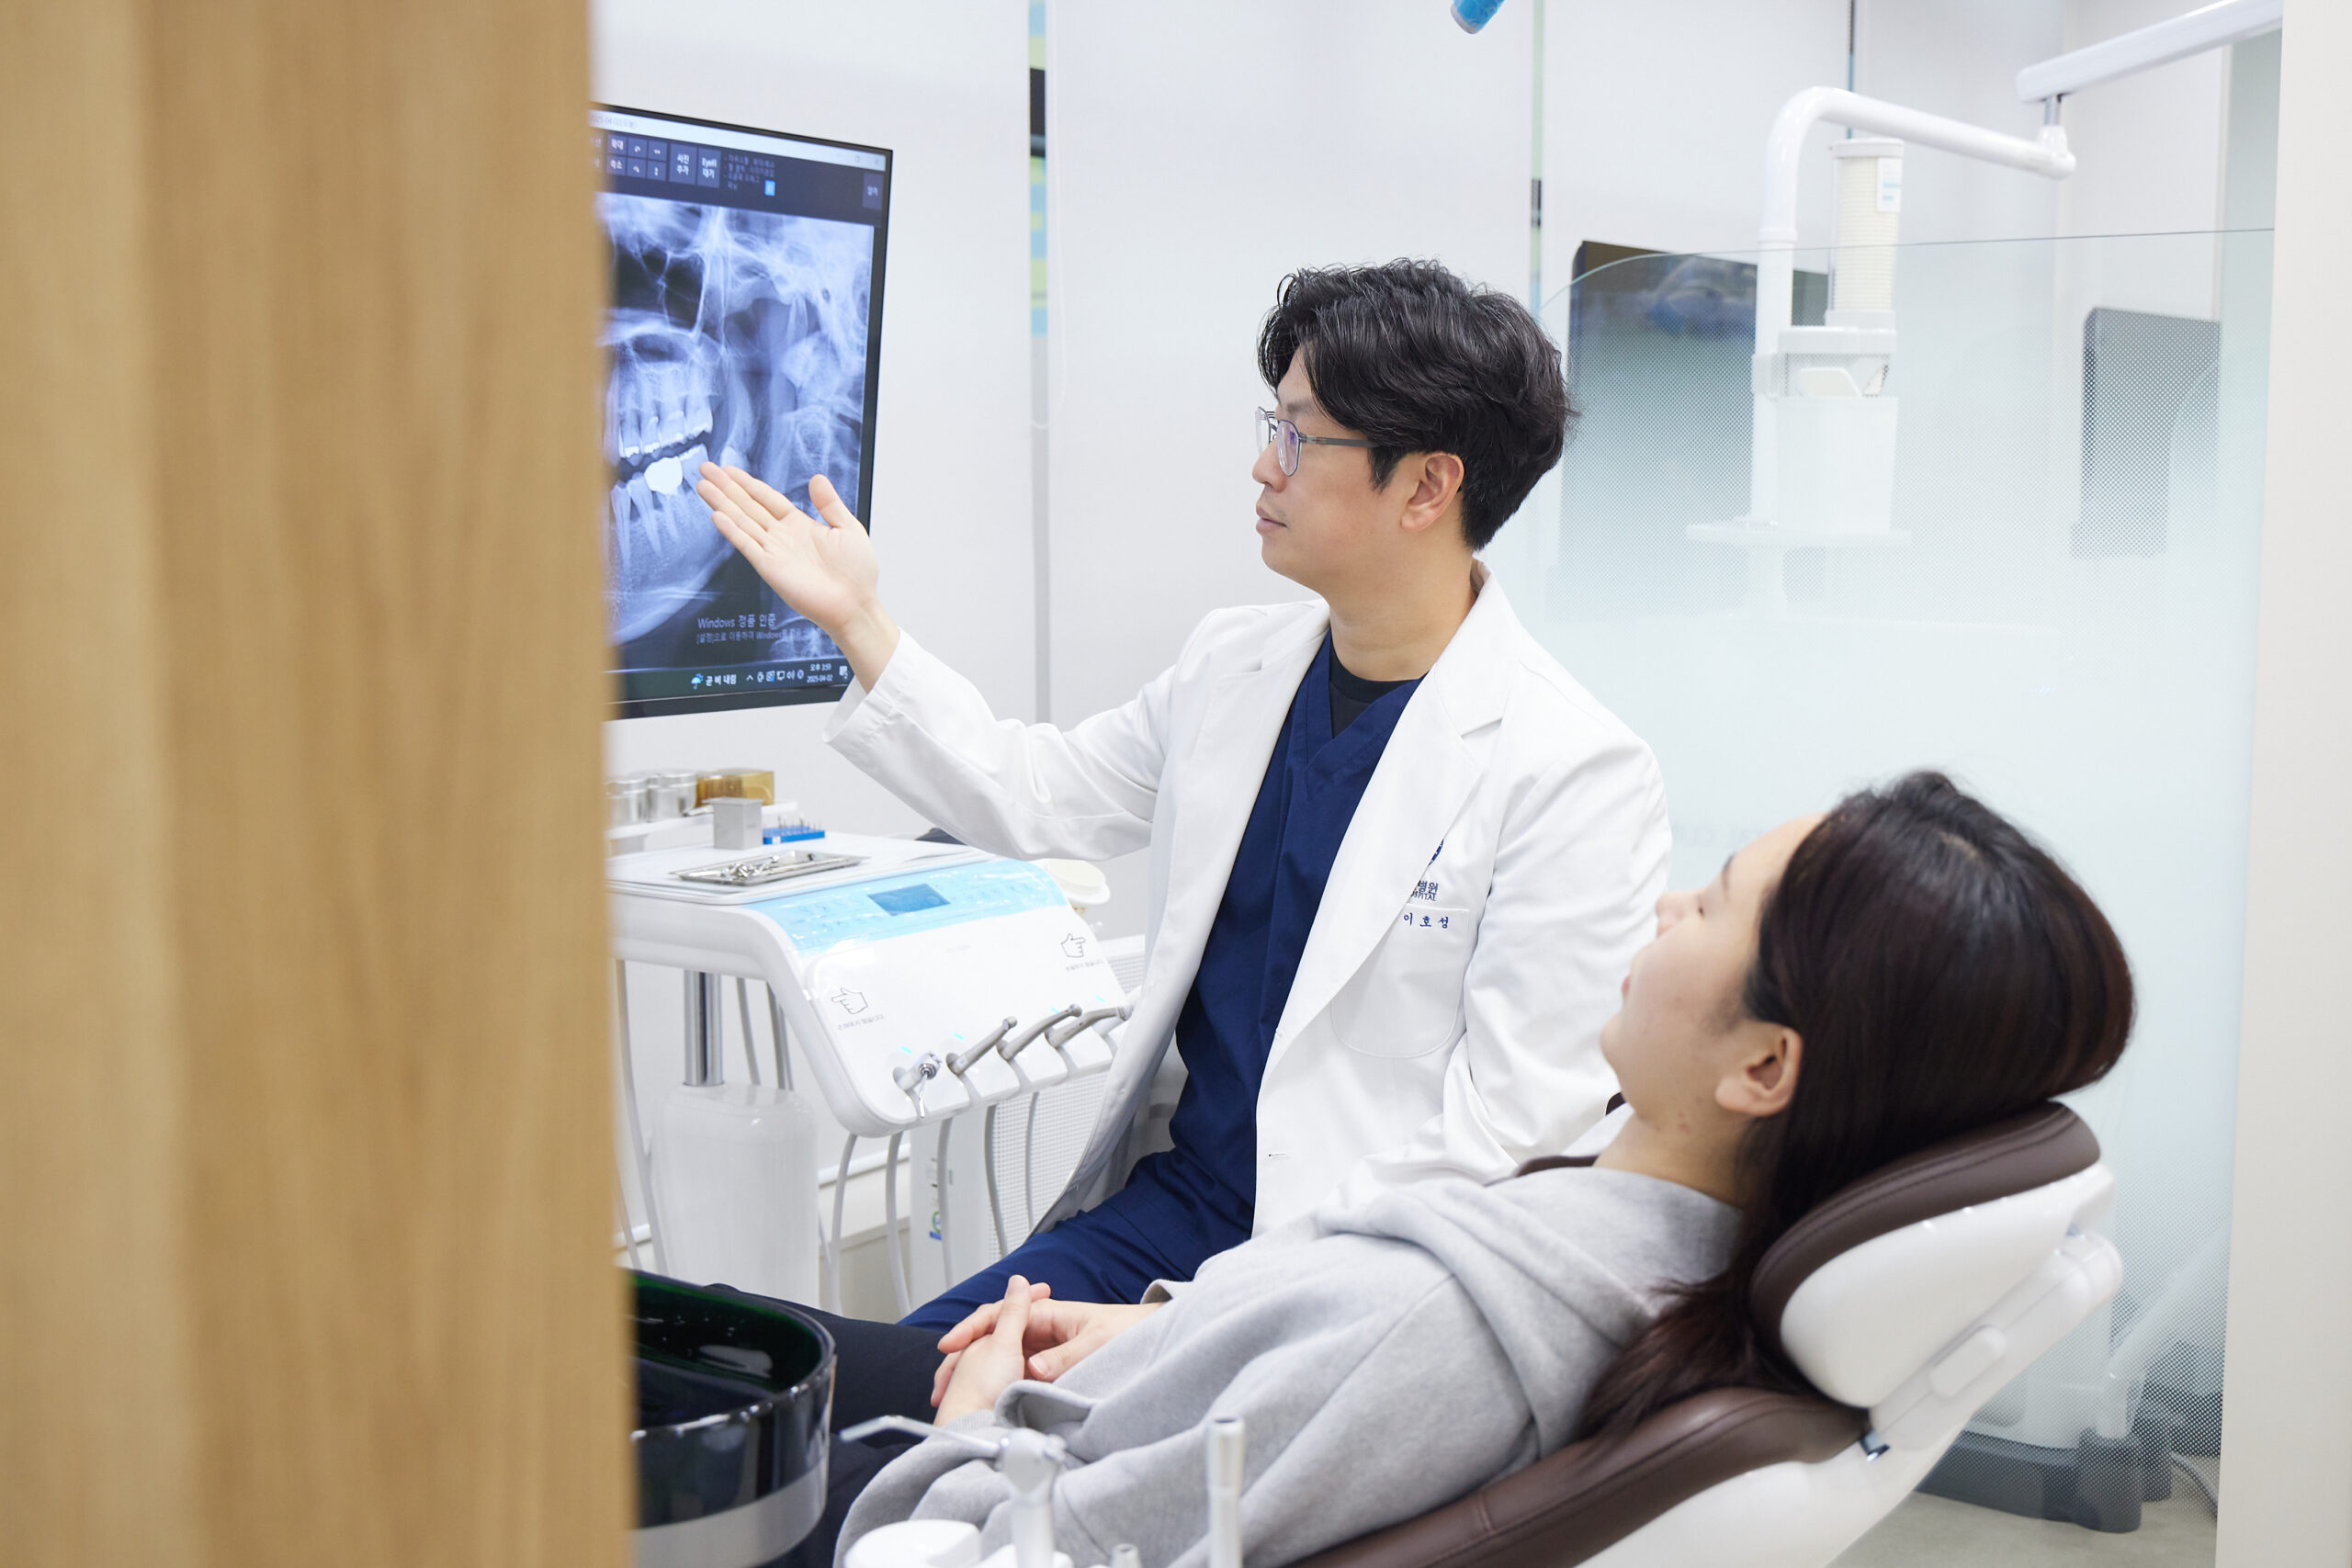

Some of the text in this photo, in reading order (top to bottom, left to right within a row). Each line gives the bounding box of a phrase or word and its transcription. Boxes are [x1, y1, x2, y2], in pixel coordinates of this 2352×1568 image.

[697, 613, 776, 629] Windows 정품 인증
